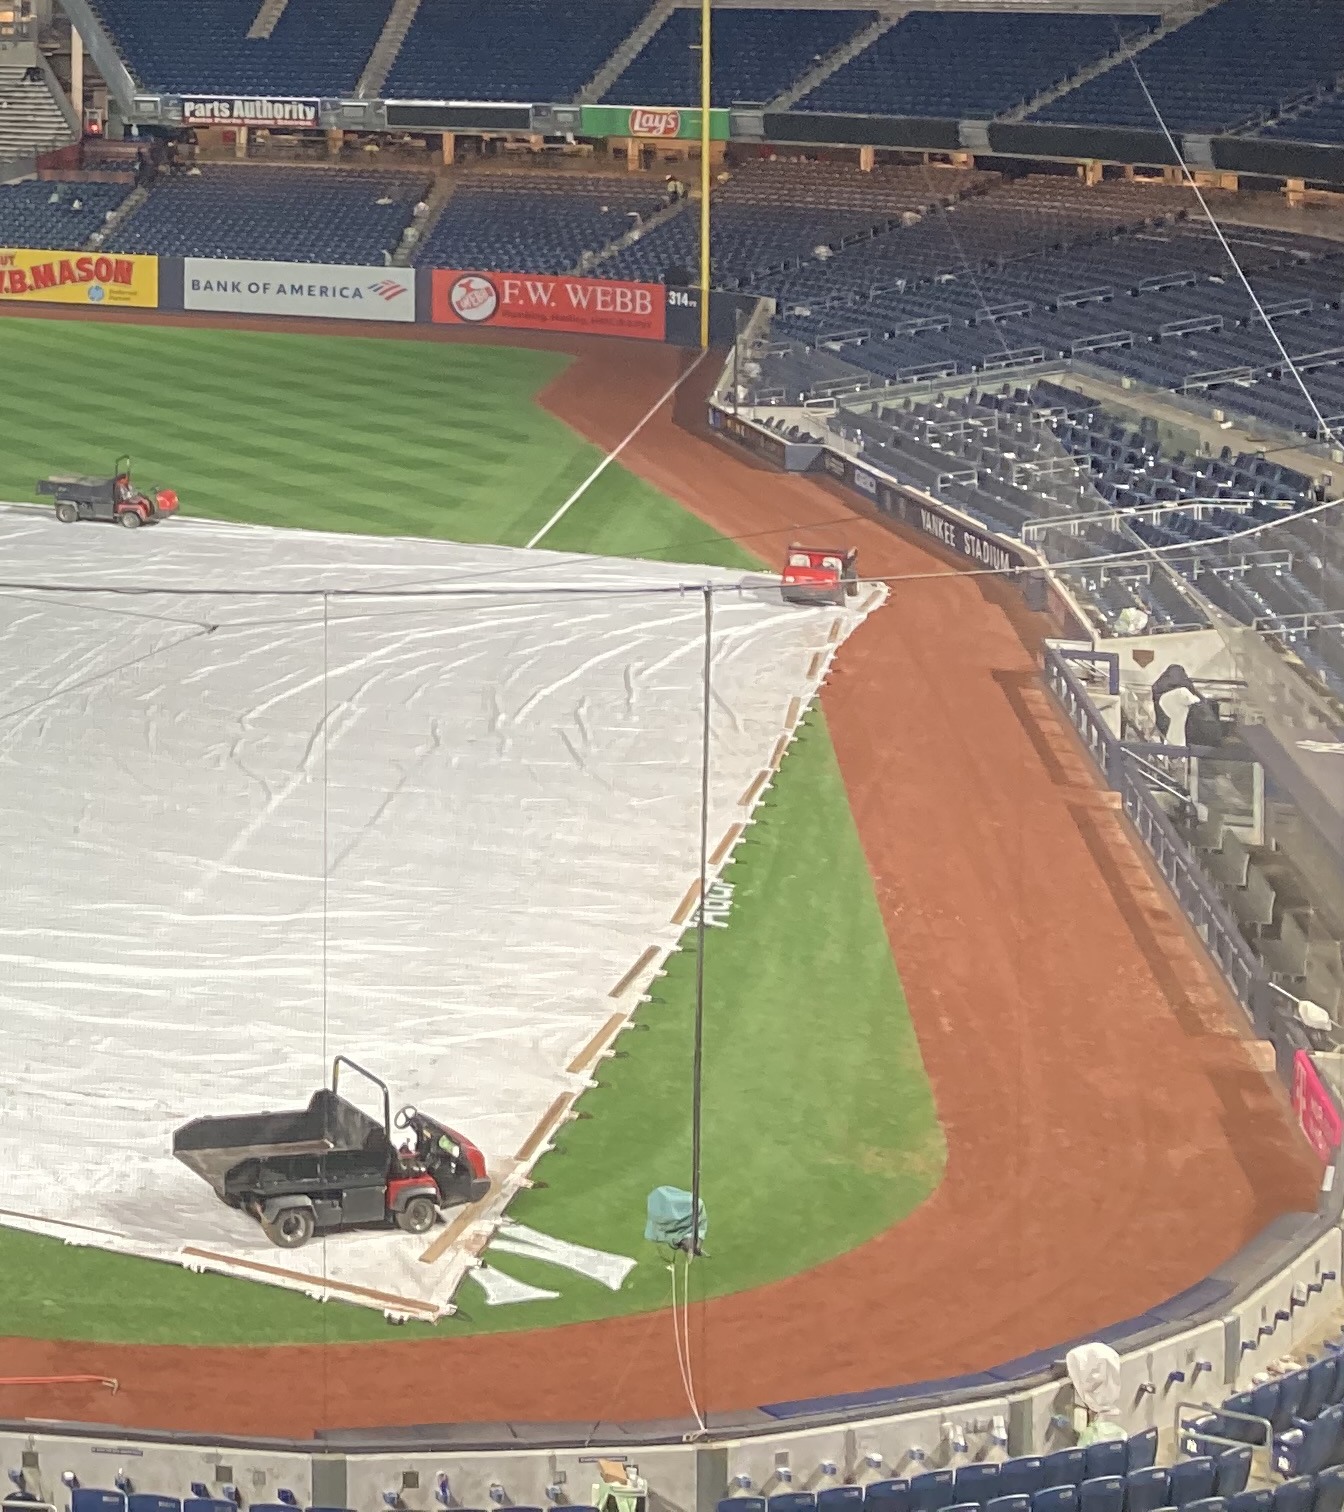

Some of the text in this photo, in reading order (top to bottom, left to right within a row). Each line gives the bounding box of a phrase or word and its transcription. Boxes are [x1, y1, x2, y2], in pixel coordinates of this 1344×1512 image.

[184, 99, 316, 120] Parts Authority
[191, 279, 364, 300] BANK OF AMERICA
[565, 284, 653, 315] WEBB
[669, 291, 688, 306] 314
[920, 507, 1010, 571] YANKEE STADIUM
